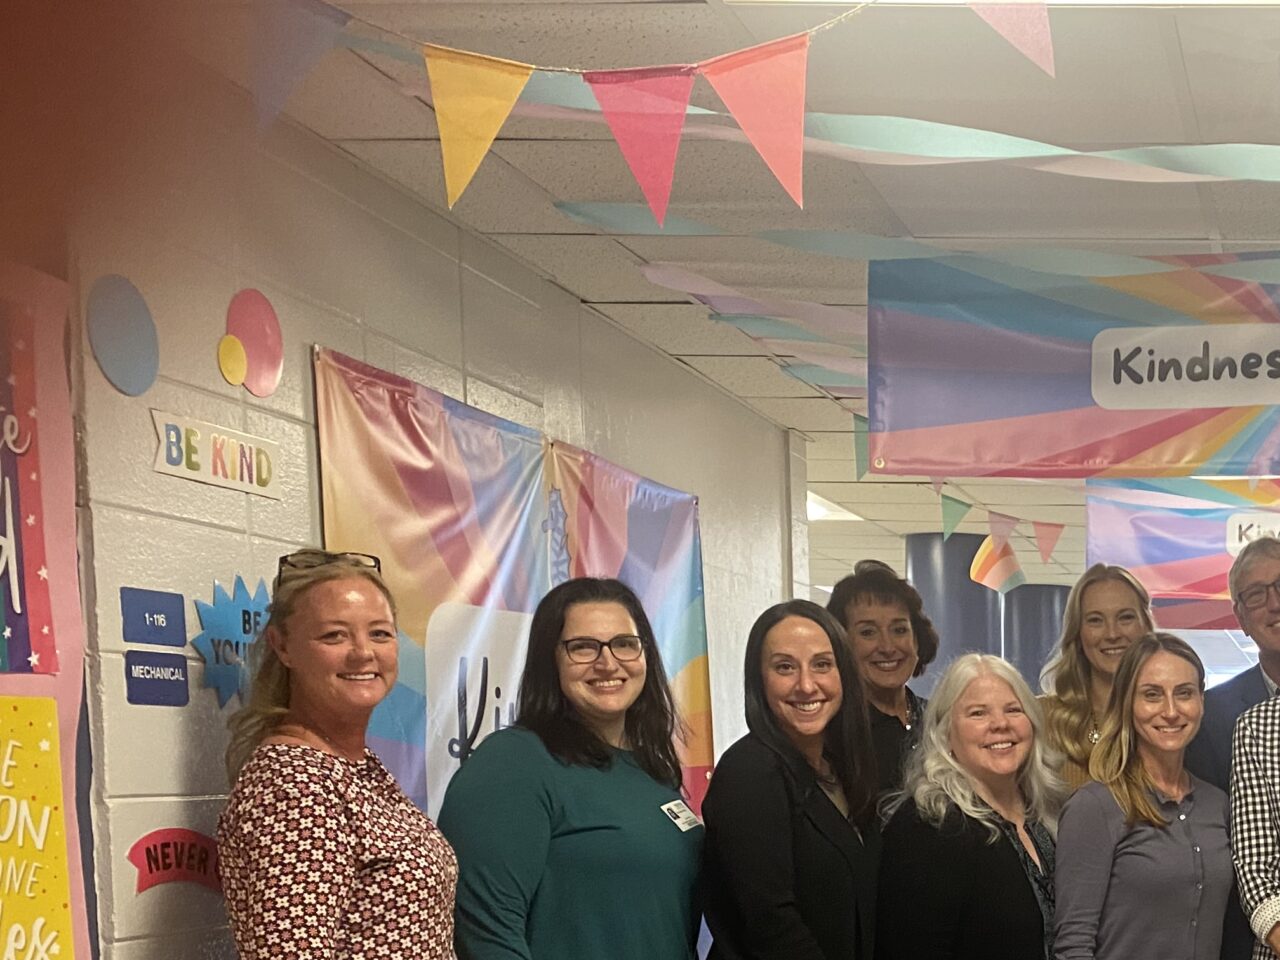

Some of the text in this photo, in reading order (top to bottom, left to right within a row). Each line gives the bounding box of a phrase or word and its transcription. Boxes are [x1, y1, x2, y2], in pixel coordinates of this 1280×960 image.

[165, 423, 272, 489] BE KIND
[144, 612, 167, 627] 1-116
[131, 664, 186, 682] MECHANICAL
[145, 841, 210, 876] NEVER
